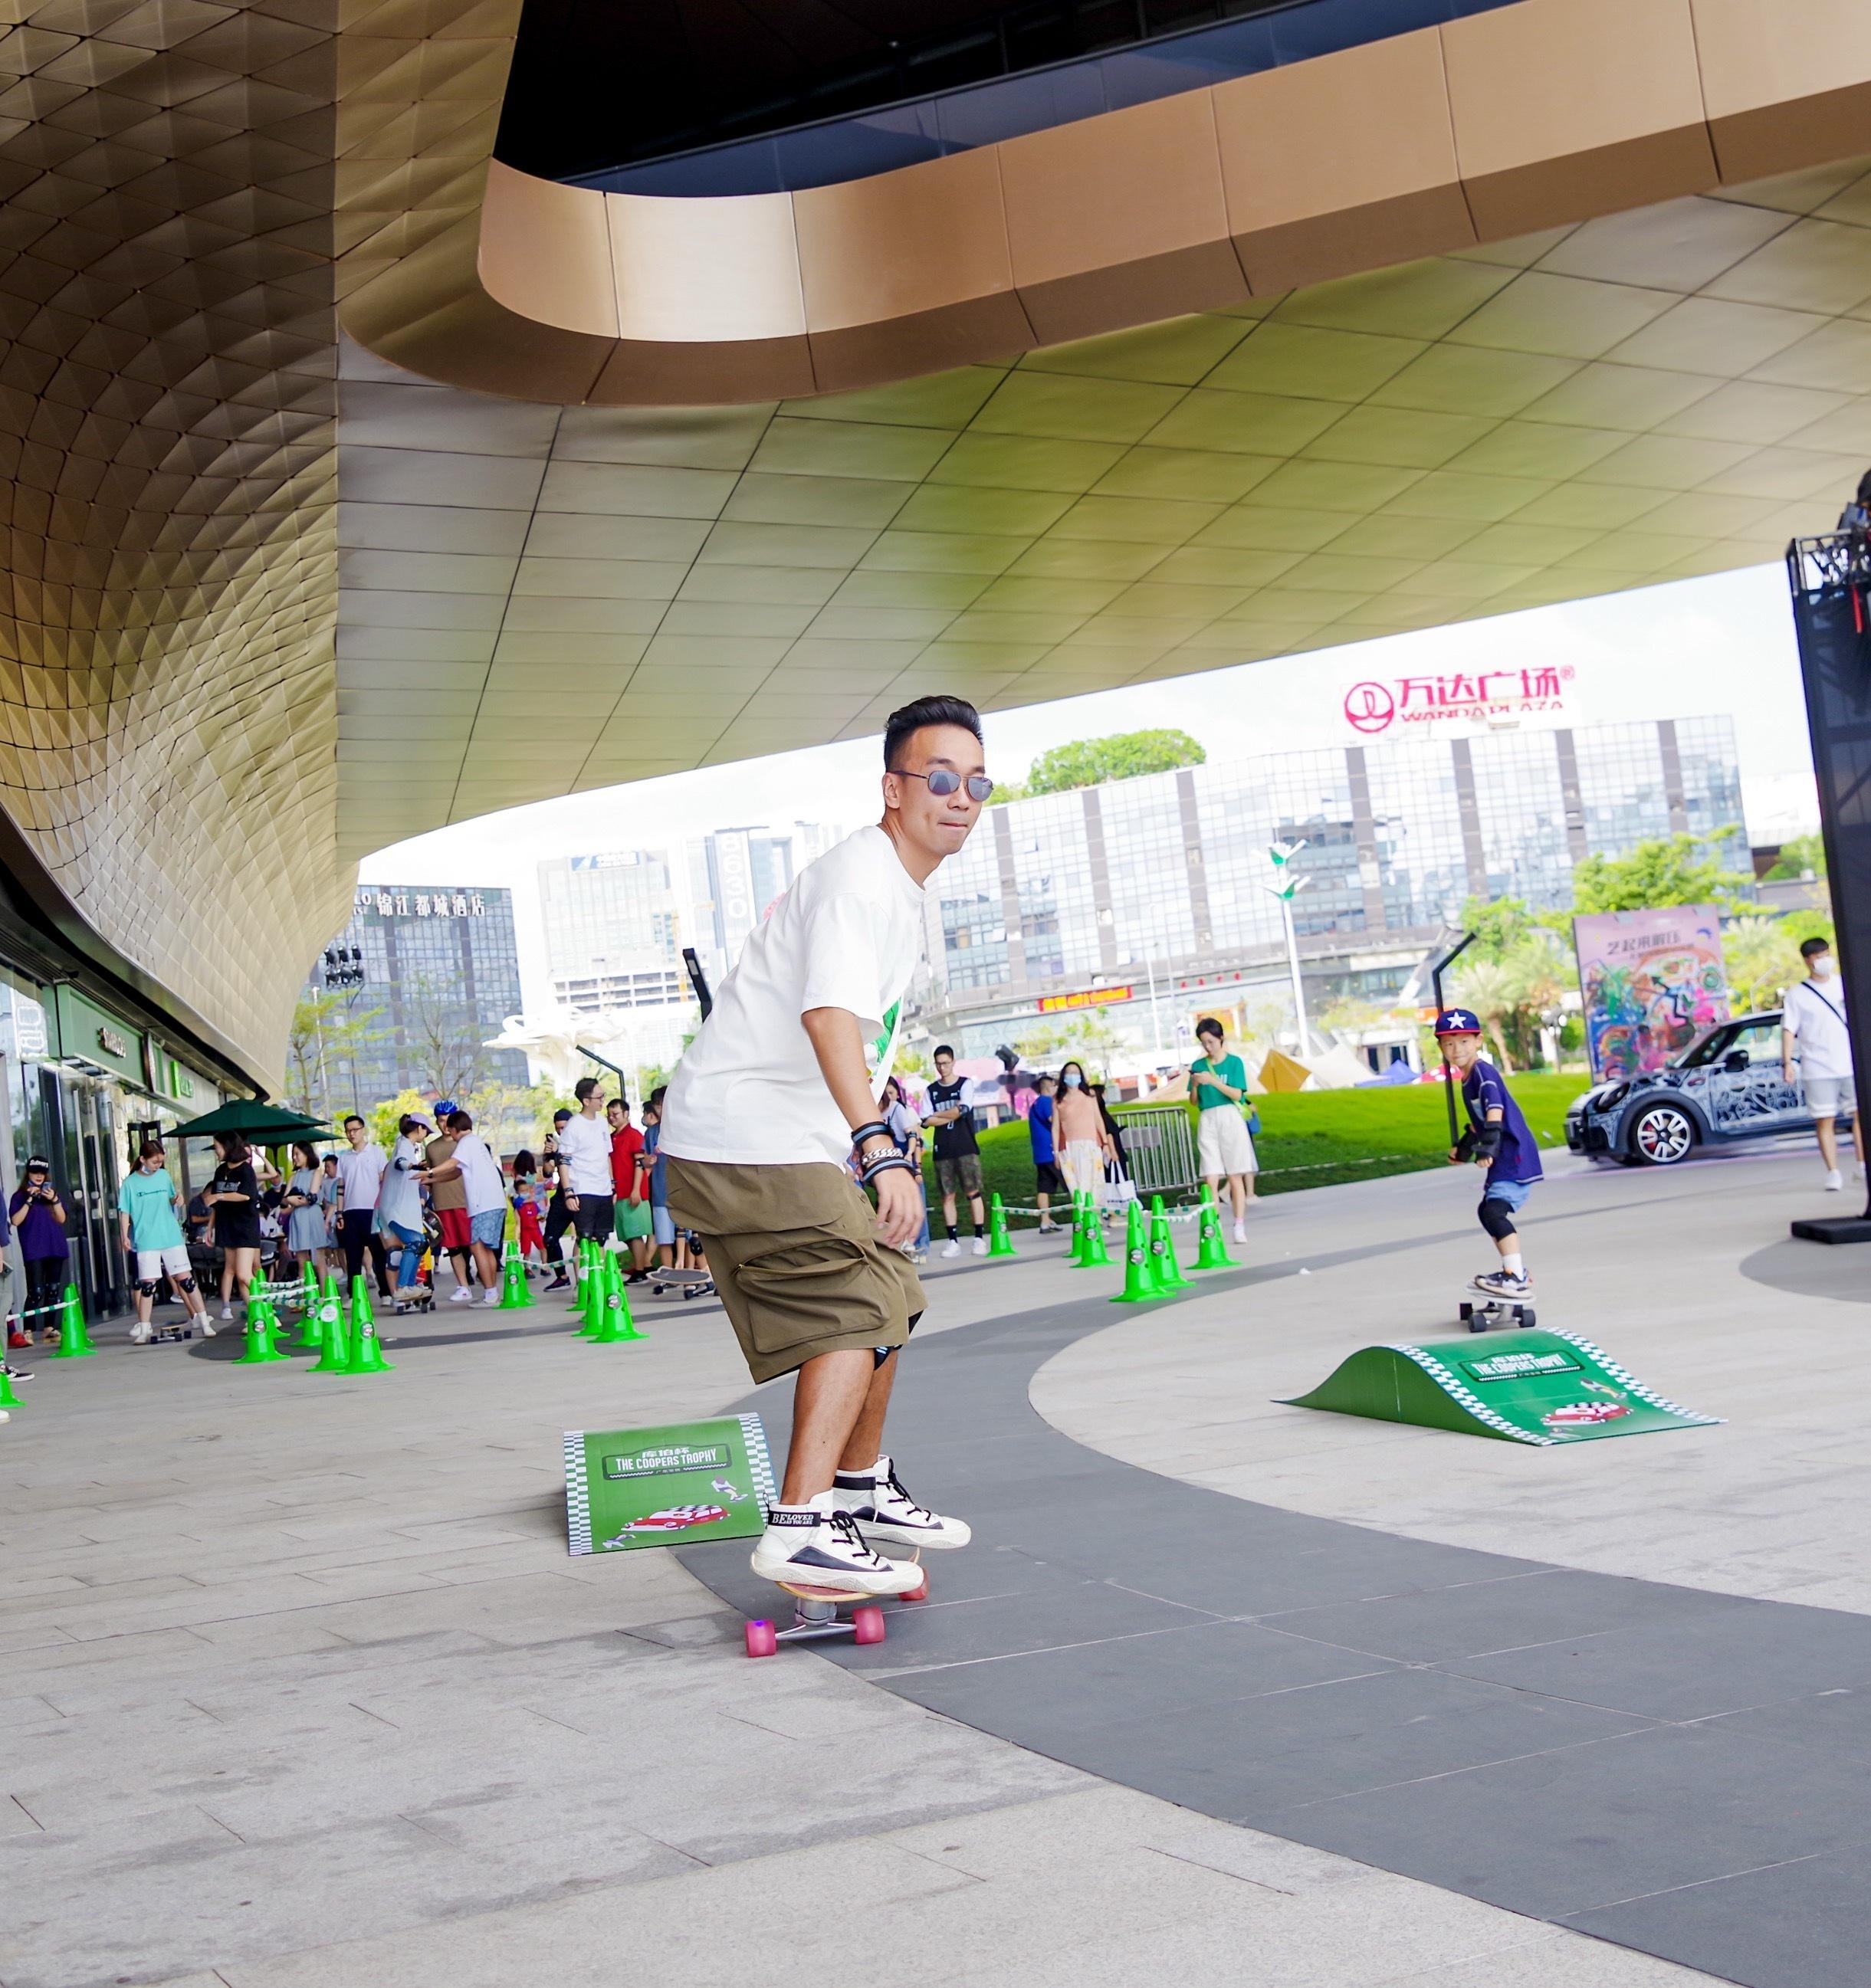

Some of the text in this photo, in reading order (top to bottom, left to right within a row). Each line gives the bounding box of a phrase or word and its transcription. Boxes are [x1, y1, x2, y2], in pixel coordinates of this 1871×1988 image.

[1393, 668, 1561, 708] 万达广场
[376, 893, 485, 917] 锦江都城酒店
[1471, 1363, 1496, 1376] THE
[615, 1448, 717, 1471] THE COOPERS TROPHY
